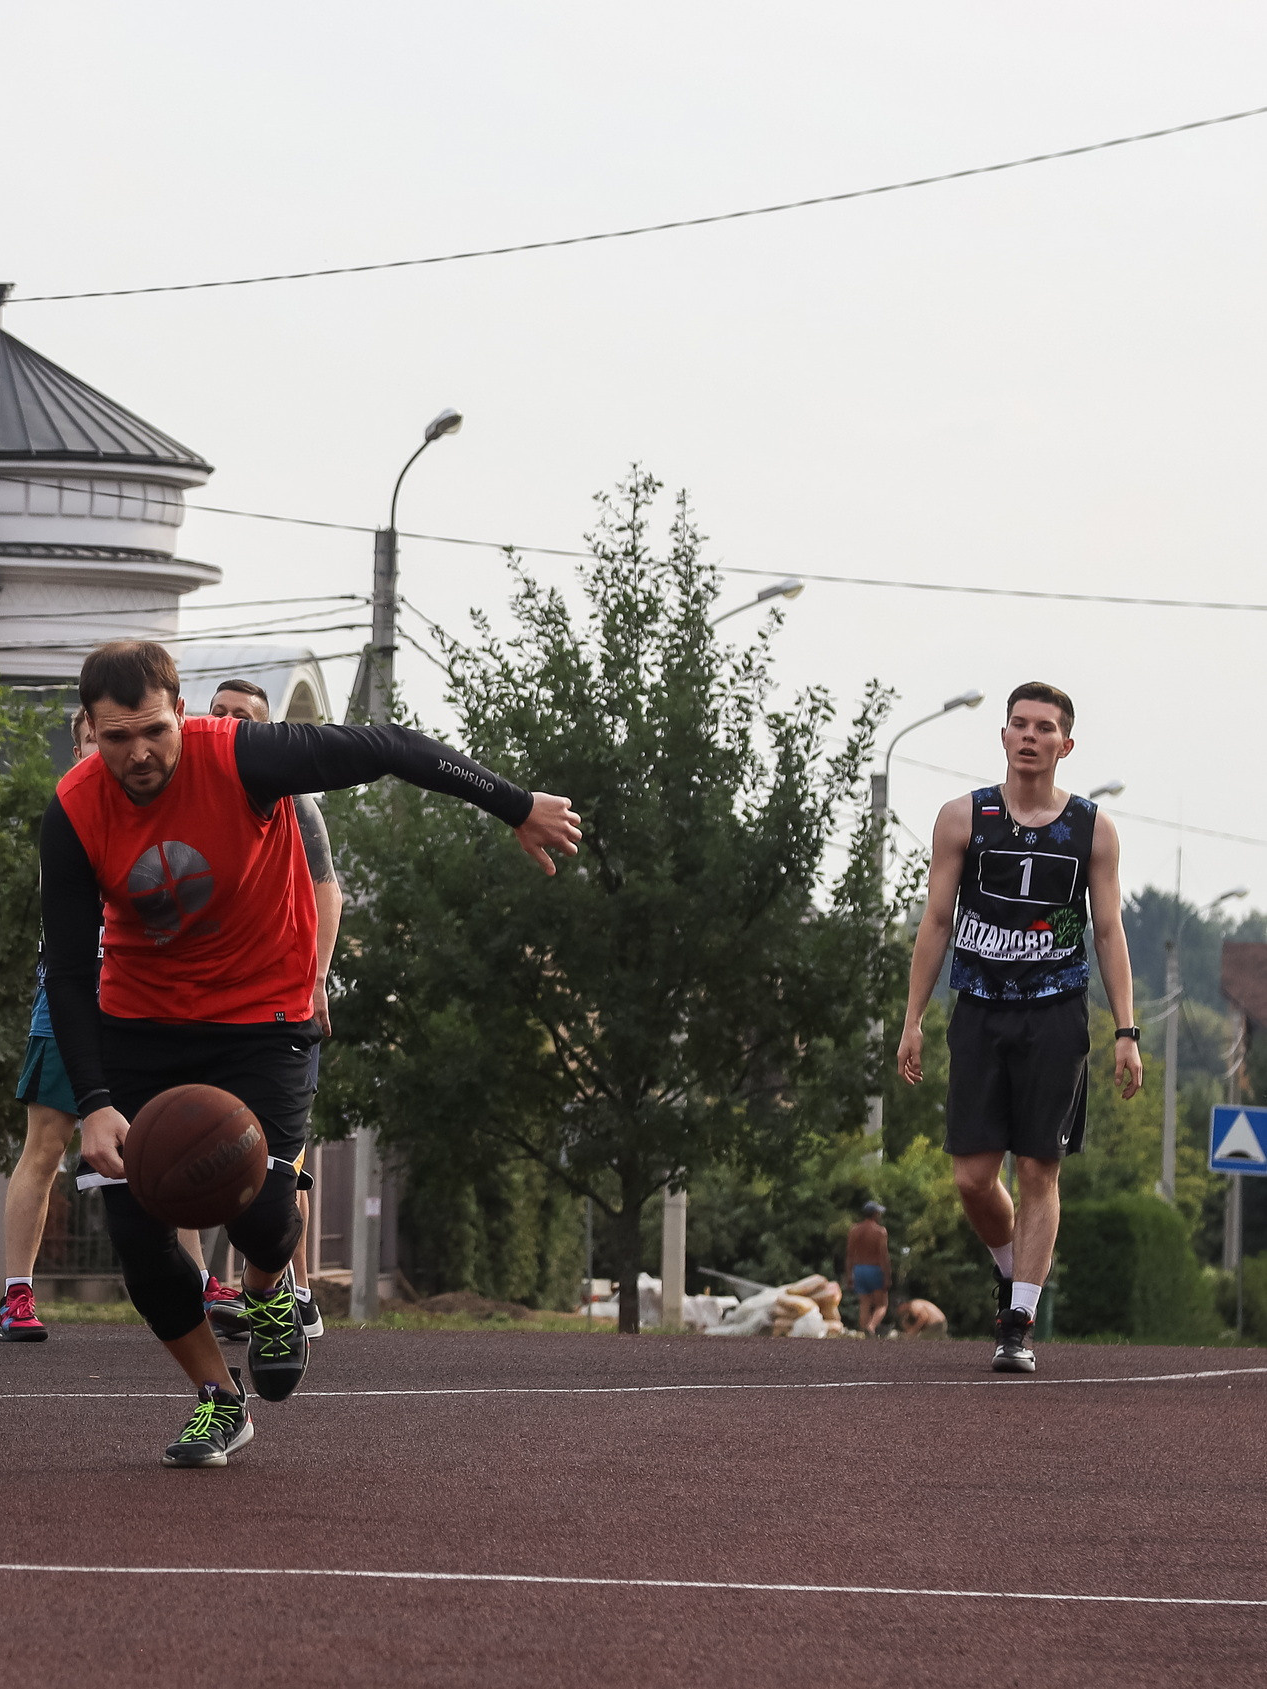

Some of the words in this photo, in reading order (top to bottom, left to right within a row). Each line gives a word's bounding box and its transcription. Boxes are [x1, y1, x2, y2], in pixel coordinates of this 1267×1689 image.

[437, 758, 495, 793] OUTSHOCK
[1019, 856, 1033, 897] 1
[959, 938, 980, 953] Мо
[183, 1123, 262, 1188] Wilson
